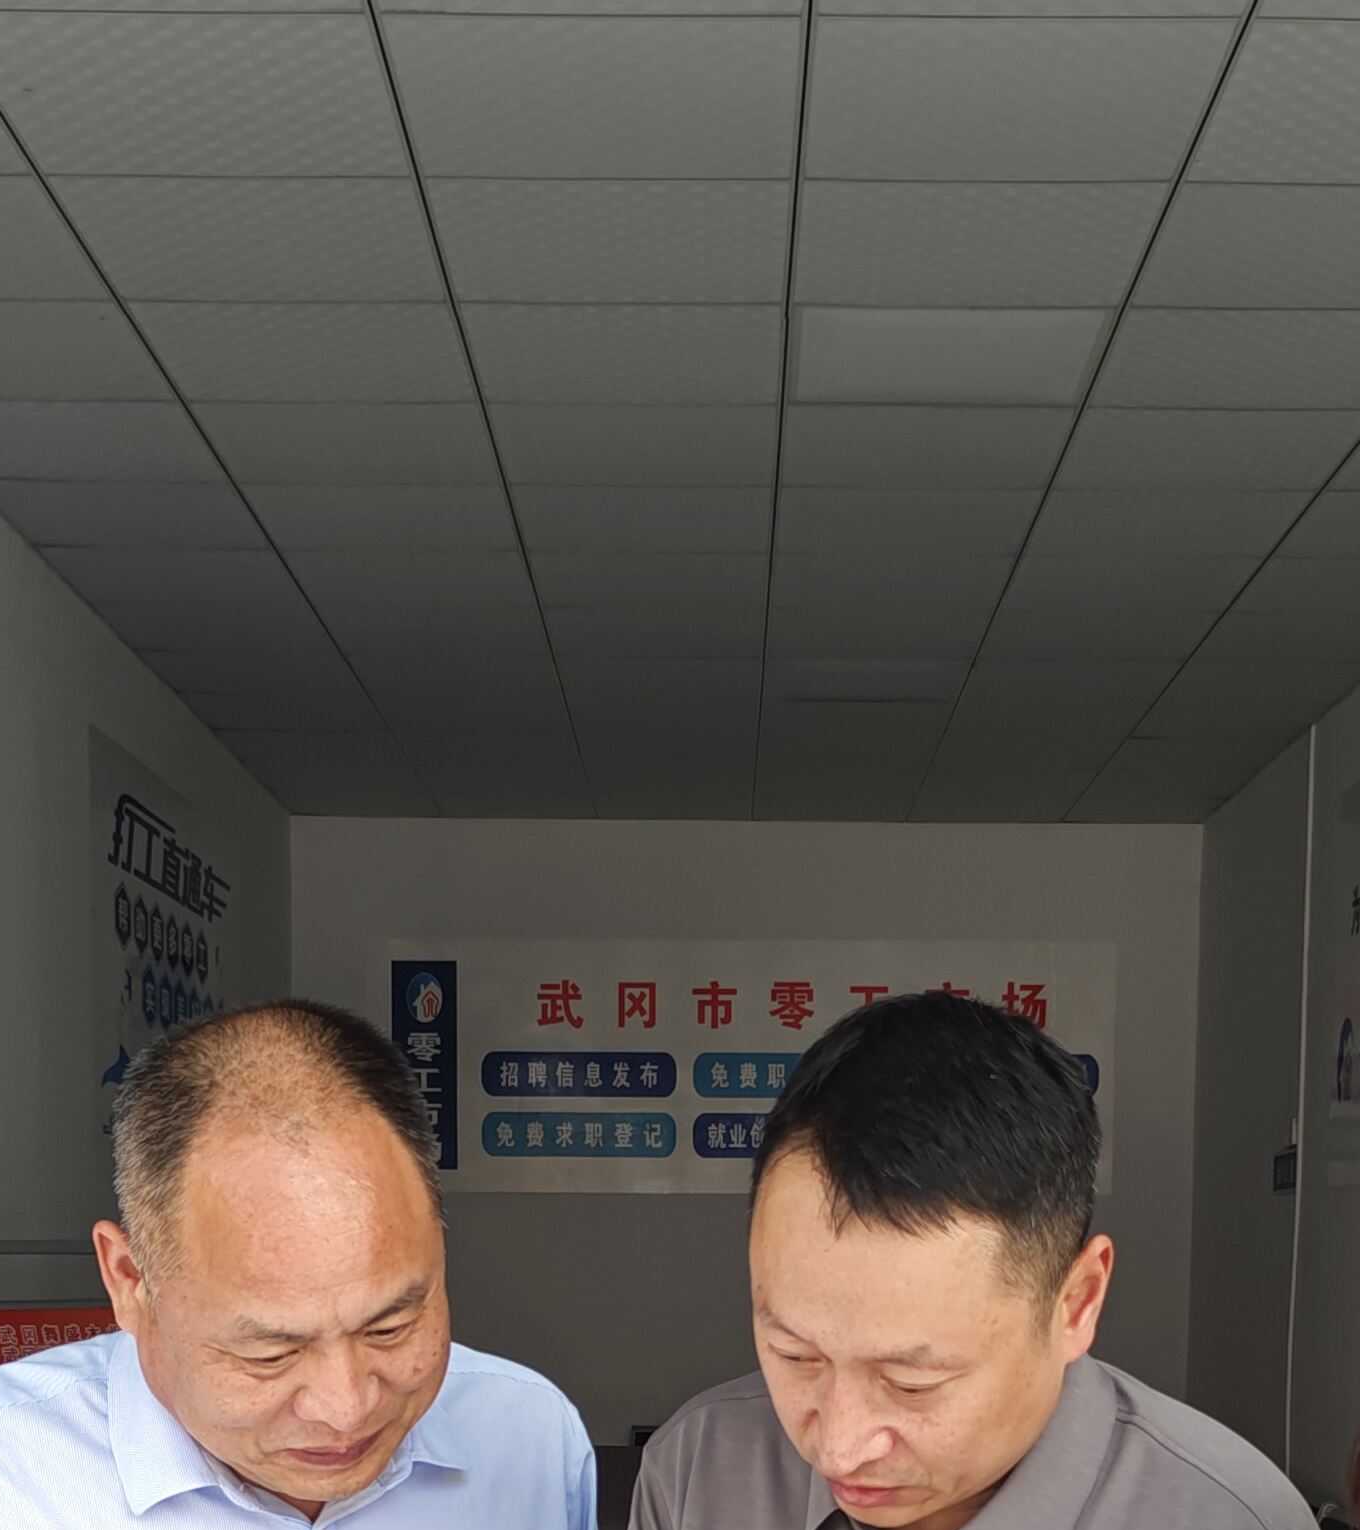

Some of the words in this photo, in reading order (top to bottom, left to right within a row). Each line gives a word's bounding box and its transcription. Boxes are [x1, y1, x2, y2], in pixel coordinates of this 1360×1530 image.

[106, 793, 232, 923] 打工直通车
[536, 980, 1049, 1031] 武冈市零场
[499, 1062, 660, 1089] 招聘信息发布
[711, 1062, 787, 1089] 免费职
[497, 1121, 663, 1150] 免费求职登记
